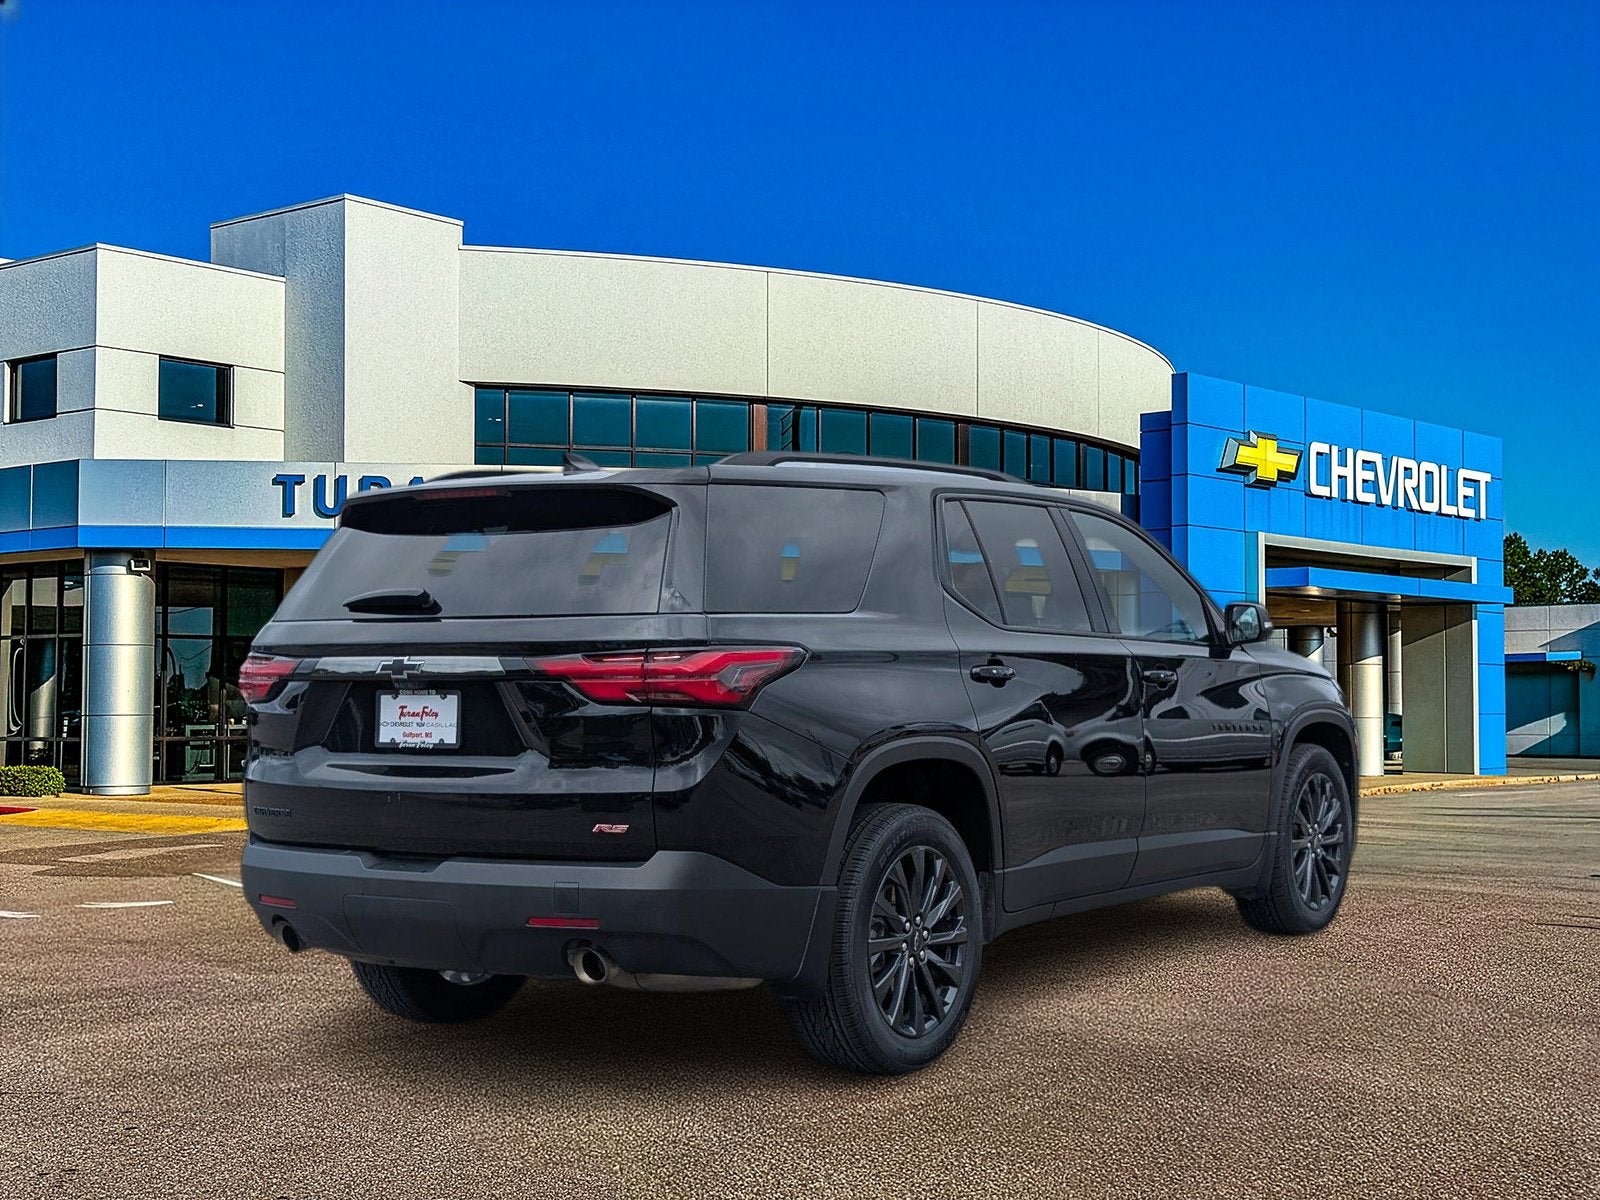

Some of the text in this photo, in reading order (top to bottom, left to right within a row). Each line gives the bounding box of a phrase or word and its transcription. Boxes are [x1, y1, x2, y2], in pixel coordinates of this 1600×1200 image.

[271, 473, 425, 519] TU
[1305, 441, 1492, 521] CHEVROLET
[592, 823, 629, 833] RS
